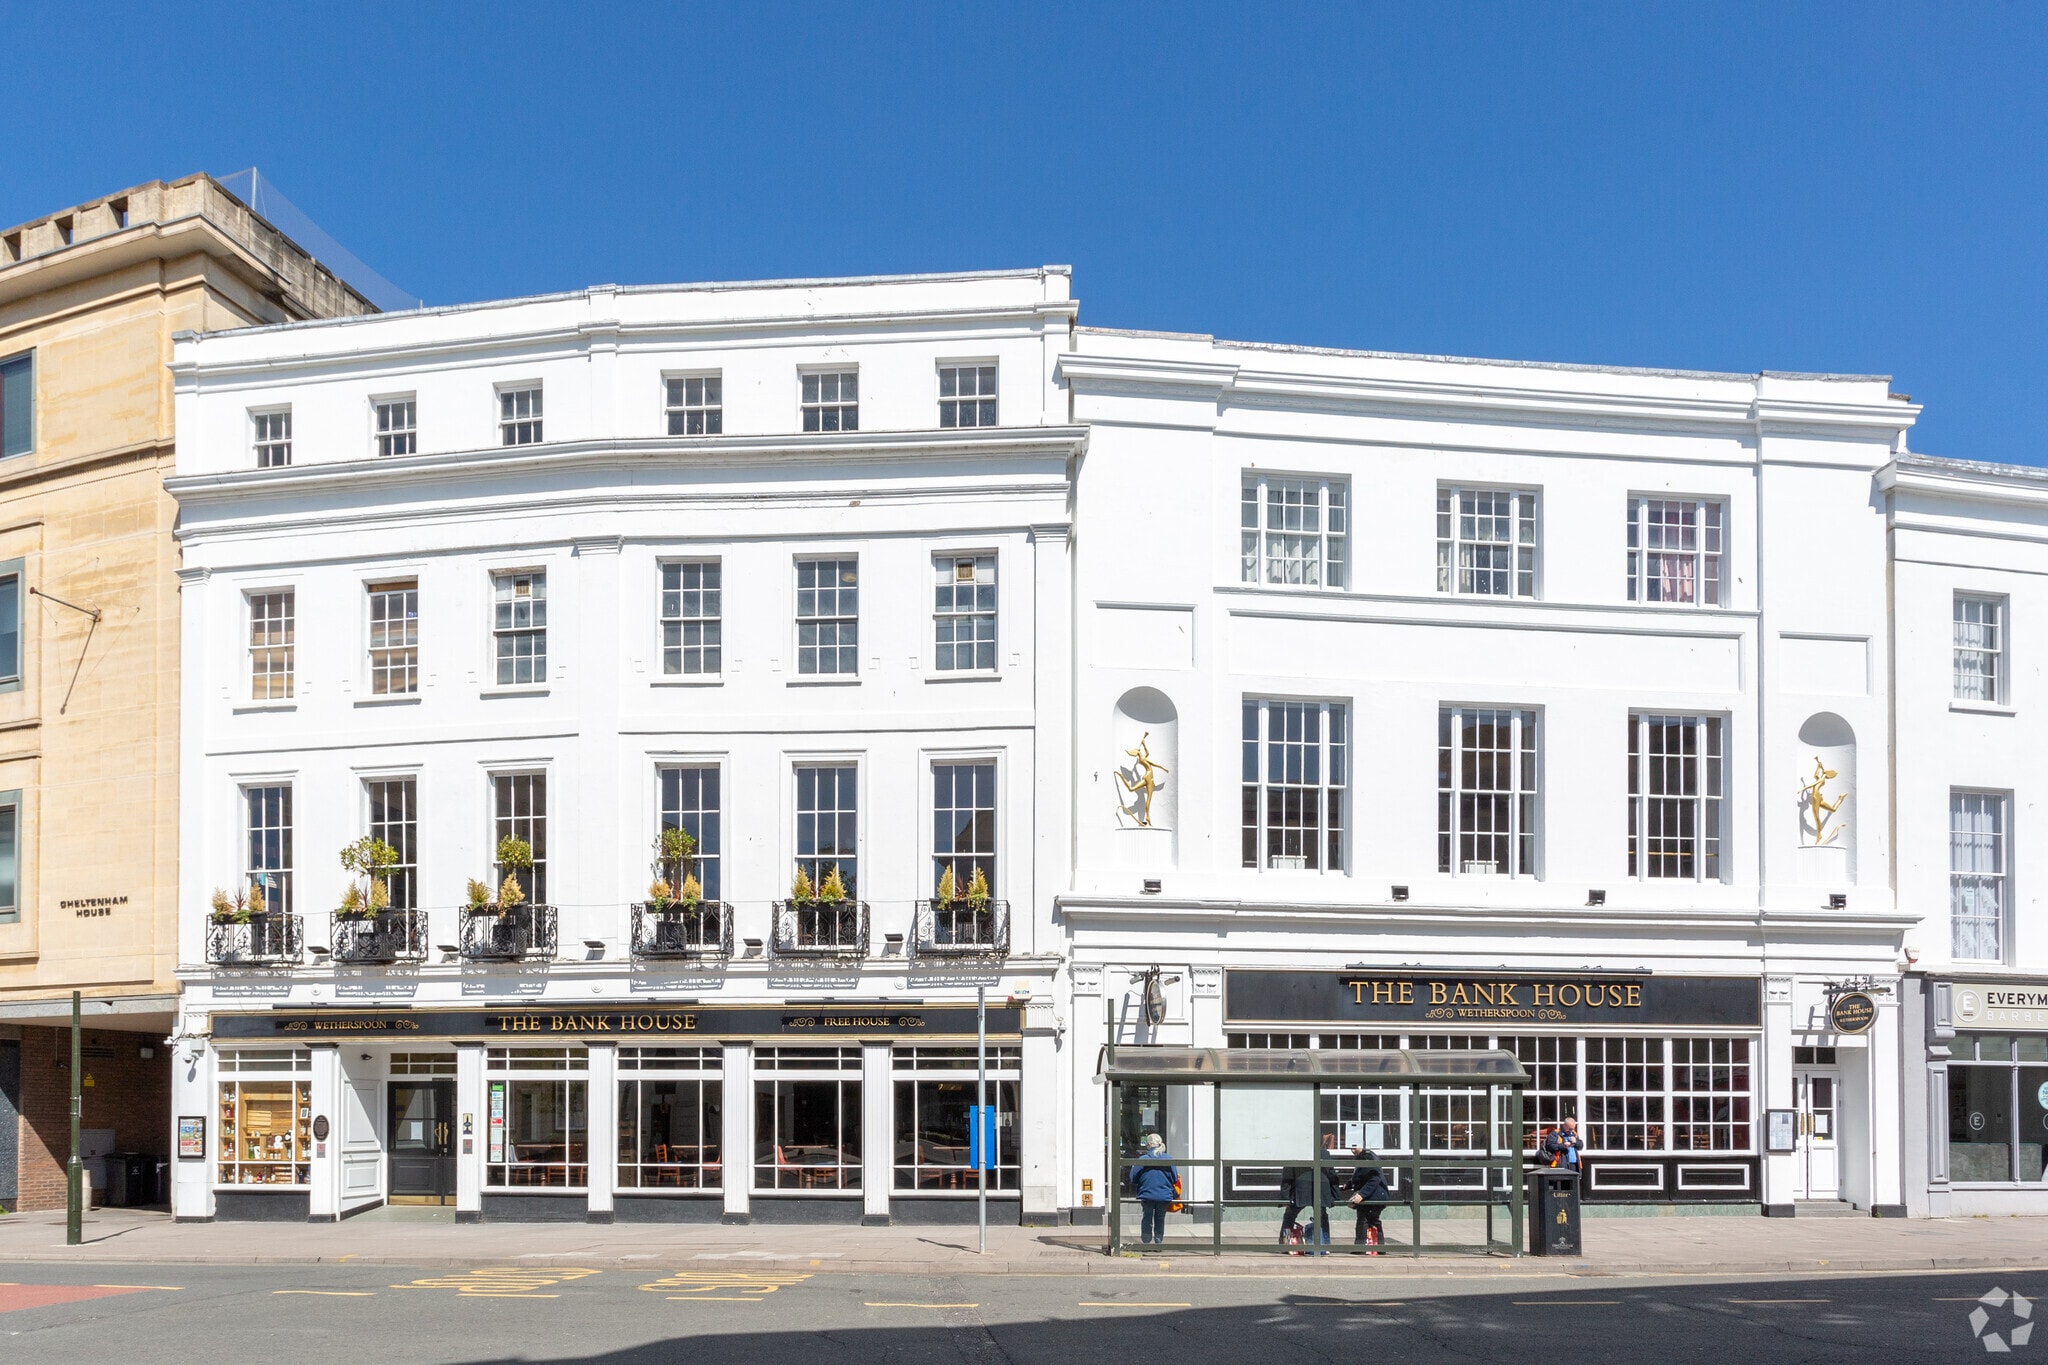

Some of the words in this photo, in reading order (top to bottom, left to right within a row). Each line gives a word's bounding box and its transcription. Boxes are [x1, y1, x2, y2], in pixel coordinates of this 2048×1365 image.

[60, 896, 128, 909] CHELTENHAM
[76, 907, 111, 918] HOUSE
[1349, 981, 1414, 1004] THE
[1428, 982, 1519, 1006] BANK
[1533, 984, 1642, 1007] HOUSE
[1987, 992, 2048, 1006] EVERYM
[1963, 995, 1974, 1011] E
[1458, 1008, 1535, 1018] WETHERSPOON
[1852, 1007, 1873, 1015] HOUSE
[1987, 1010, 2045, 1022] BARBE
[314, 1020, 387, 1030] WETHERSPOON
[498, 1015, 541, 1031] THE
[551, 1015, 611, 1031] BANK
[620, 1014, 696, 1031] HOUSE
[824, 1017, 850, 1026] FREE
[852, 1017, 890, 1026] HOUSE
[1973, 1116, 1981, 1126] E
